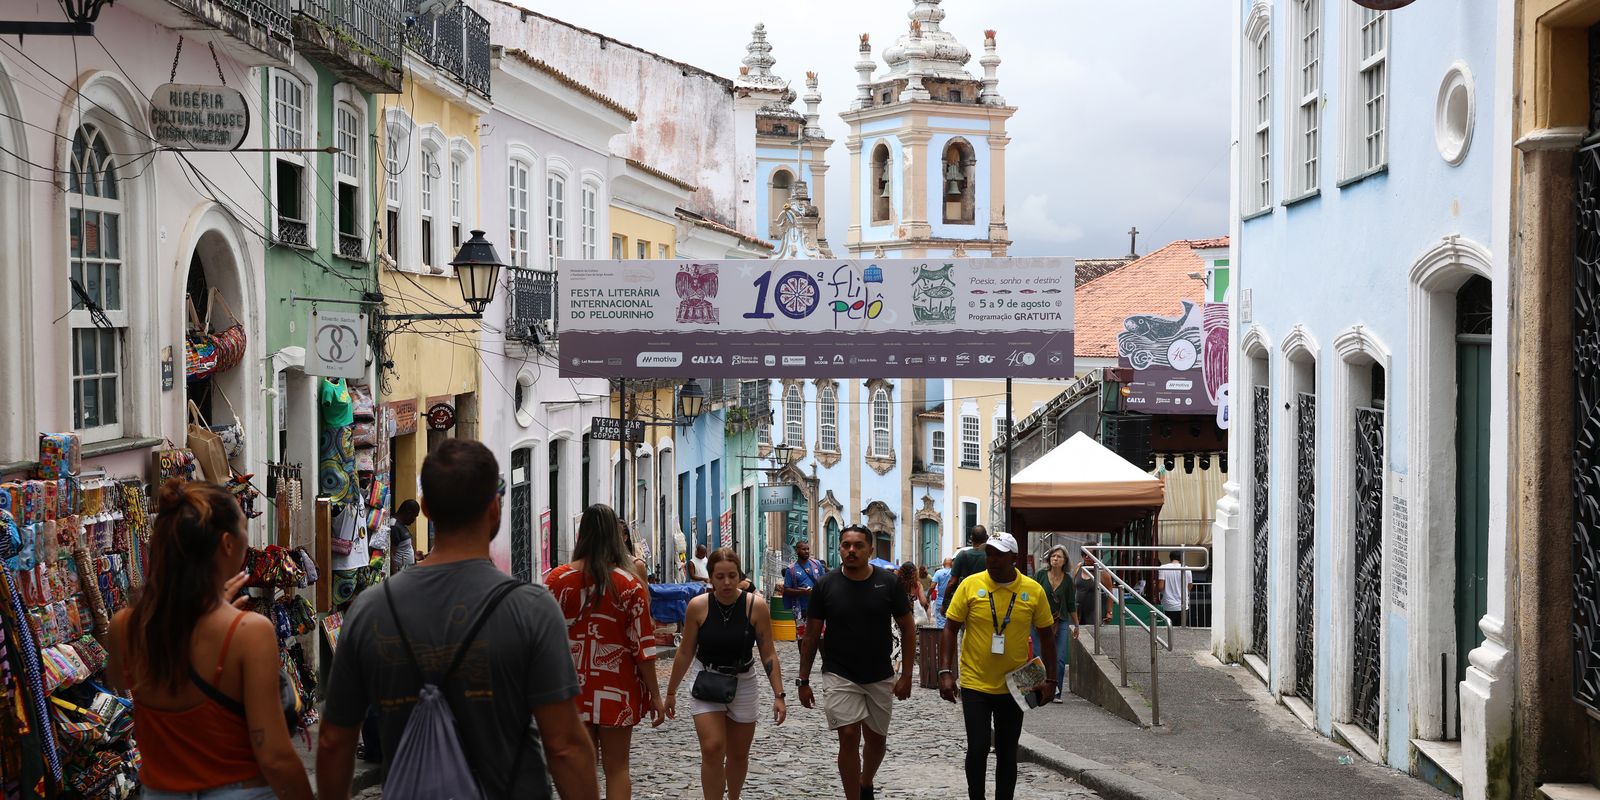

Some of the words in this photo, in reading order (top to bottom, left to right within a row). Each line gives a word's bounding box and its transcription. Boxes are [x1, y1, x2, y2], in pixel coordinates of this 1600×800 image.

[1000, 276, 1022, 285] sonho
[570, 288, 604, 297] FESTA
[608, 286, 660, 297] LITERÁRIA
[570, 299, 653, 308] INTERNACIONAL
[979, 299, 987, 309] 5
[997, 298, 1004, 309] 9
[1006, 299, 1018, 308] de
[1020, 300, 1051, 310] agosto
[571, 310, 585, 319] DO
[590, 310, 654, 319] PELOURINHO
[968, 313, 1013, 321] Programação
[1014, 312, 1062, 320] GRATUITA
[691, 355, 723, 364] CAIXA
